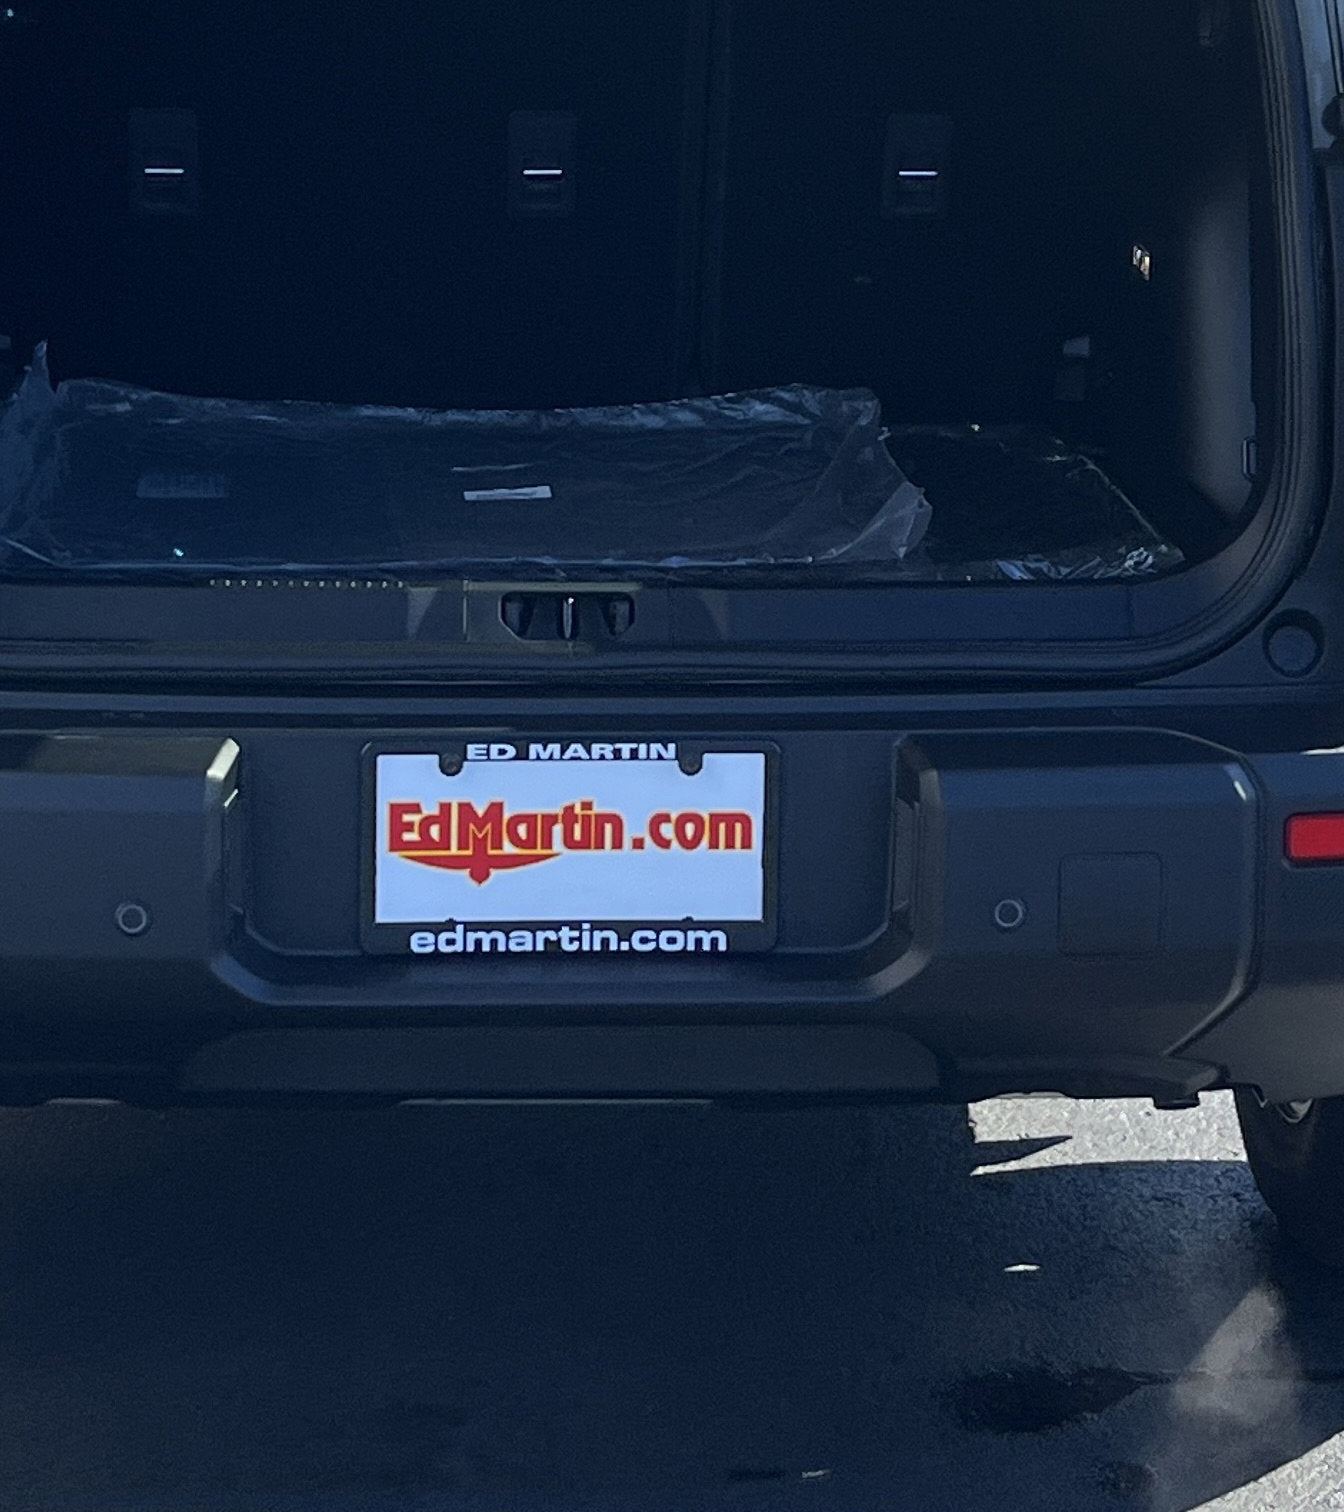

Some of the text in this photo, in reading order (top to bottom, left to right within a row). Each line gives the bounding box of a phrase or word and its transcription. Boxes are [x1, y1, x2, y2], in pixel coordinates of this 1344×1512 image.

[466, 742, 676, 761] ED MARTIN
[387, 800, 753, 852] EdMartin.com
[409, 924, 728, 955] edmartin.com
